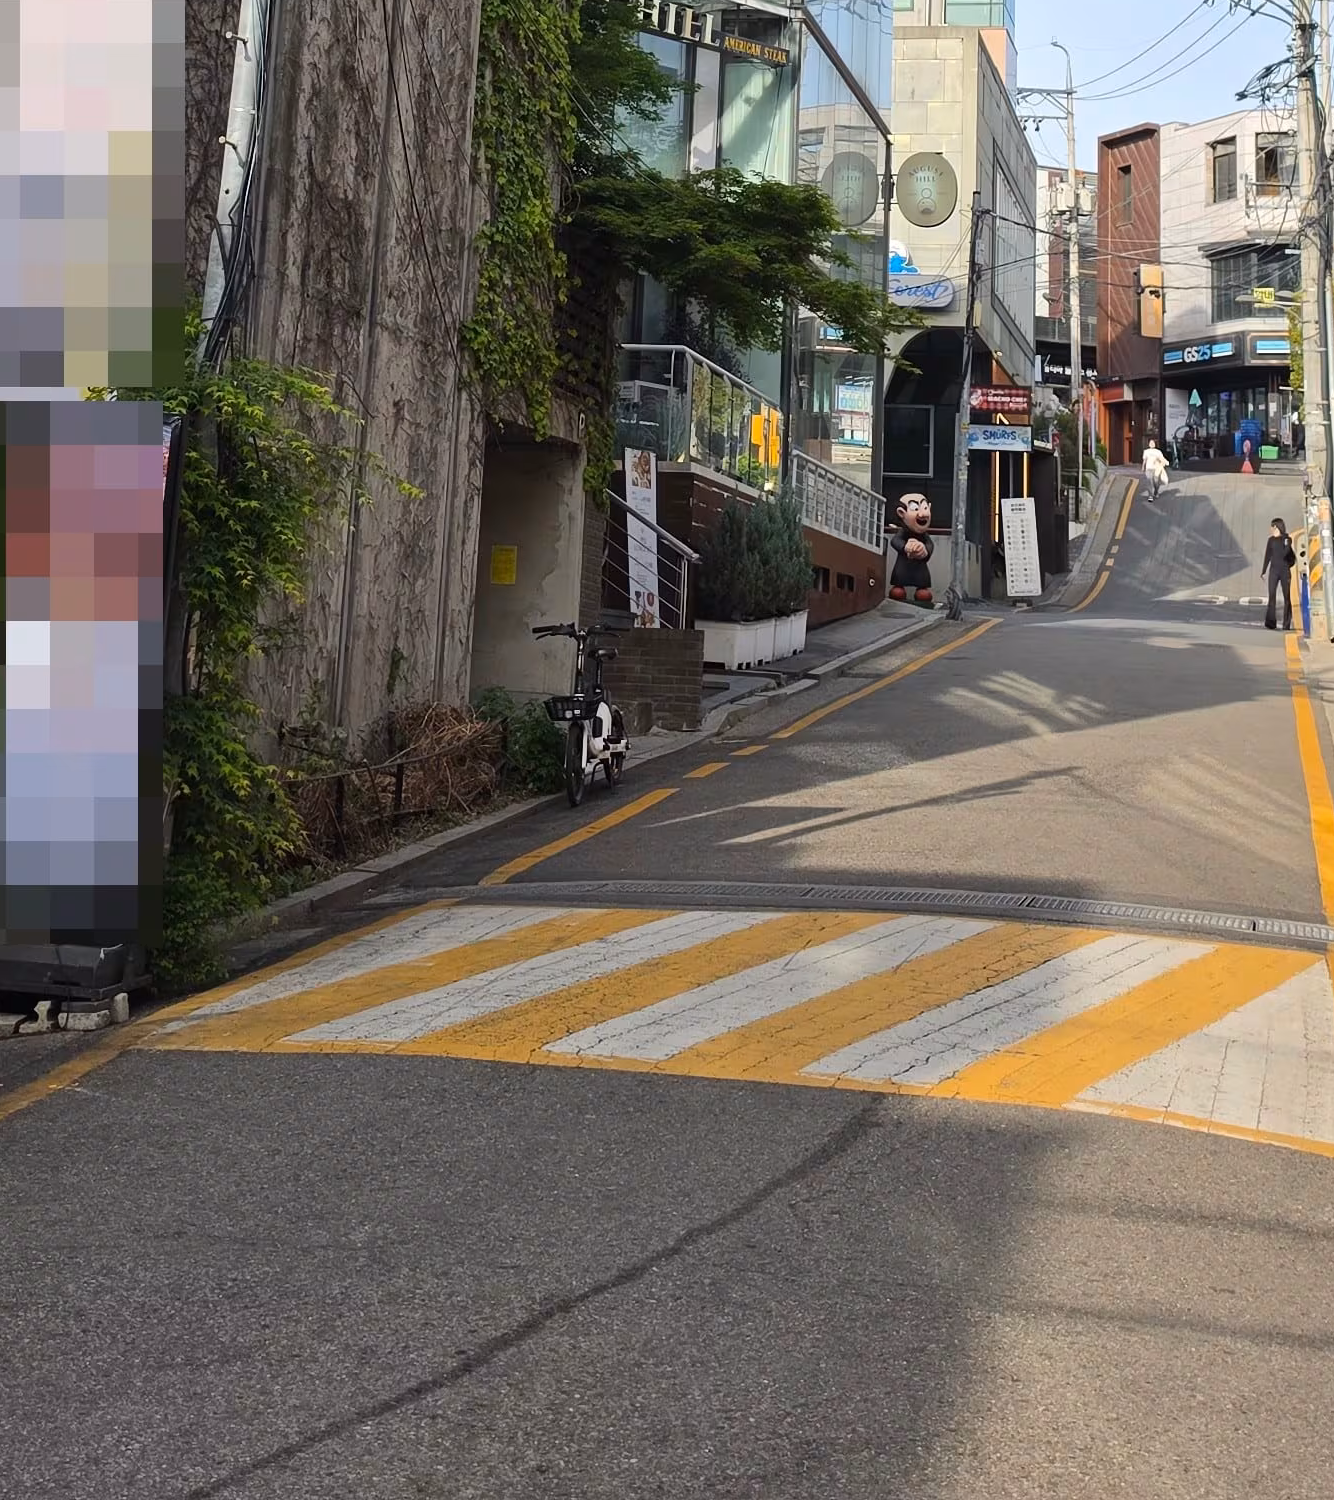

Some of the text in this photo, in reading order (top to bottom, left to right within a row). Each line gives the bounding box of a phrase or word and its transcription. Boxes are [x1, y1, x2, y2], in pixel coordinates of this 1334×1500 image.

[724, 36, 788, 64] AMERICAN STEAK
[1183, 344, 1211, 363] GS25
